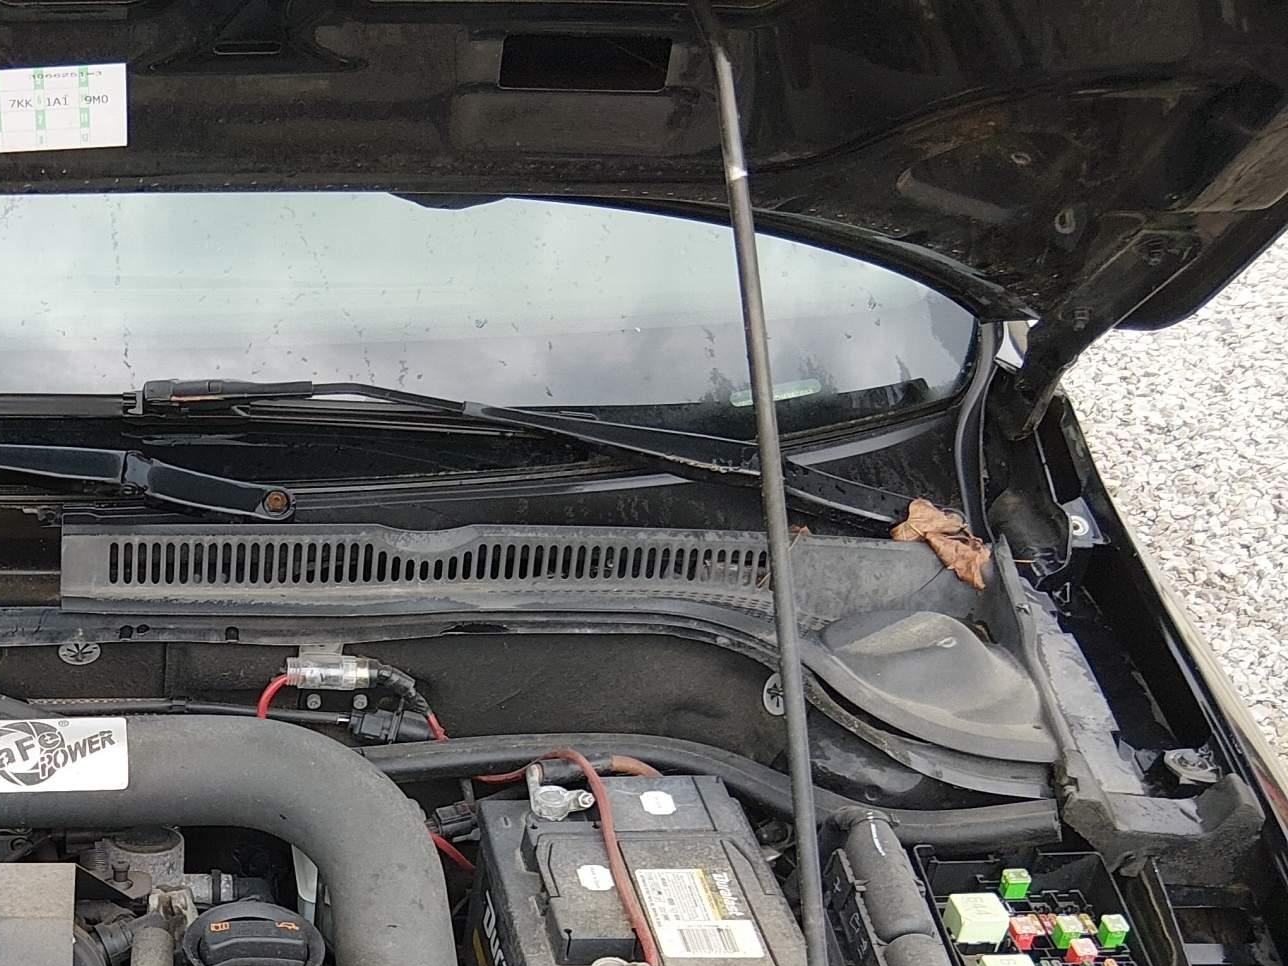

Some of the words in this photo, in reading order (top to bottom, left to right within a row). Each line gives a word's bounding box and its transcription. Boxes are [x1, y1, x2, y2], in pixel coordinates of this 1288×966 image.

[8, 99, 33, 109] 7KK
[40, 730, 116, 778] POWER
[712, 873, 745, 917] Duralast
